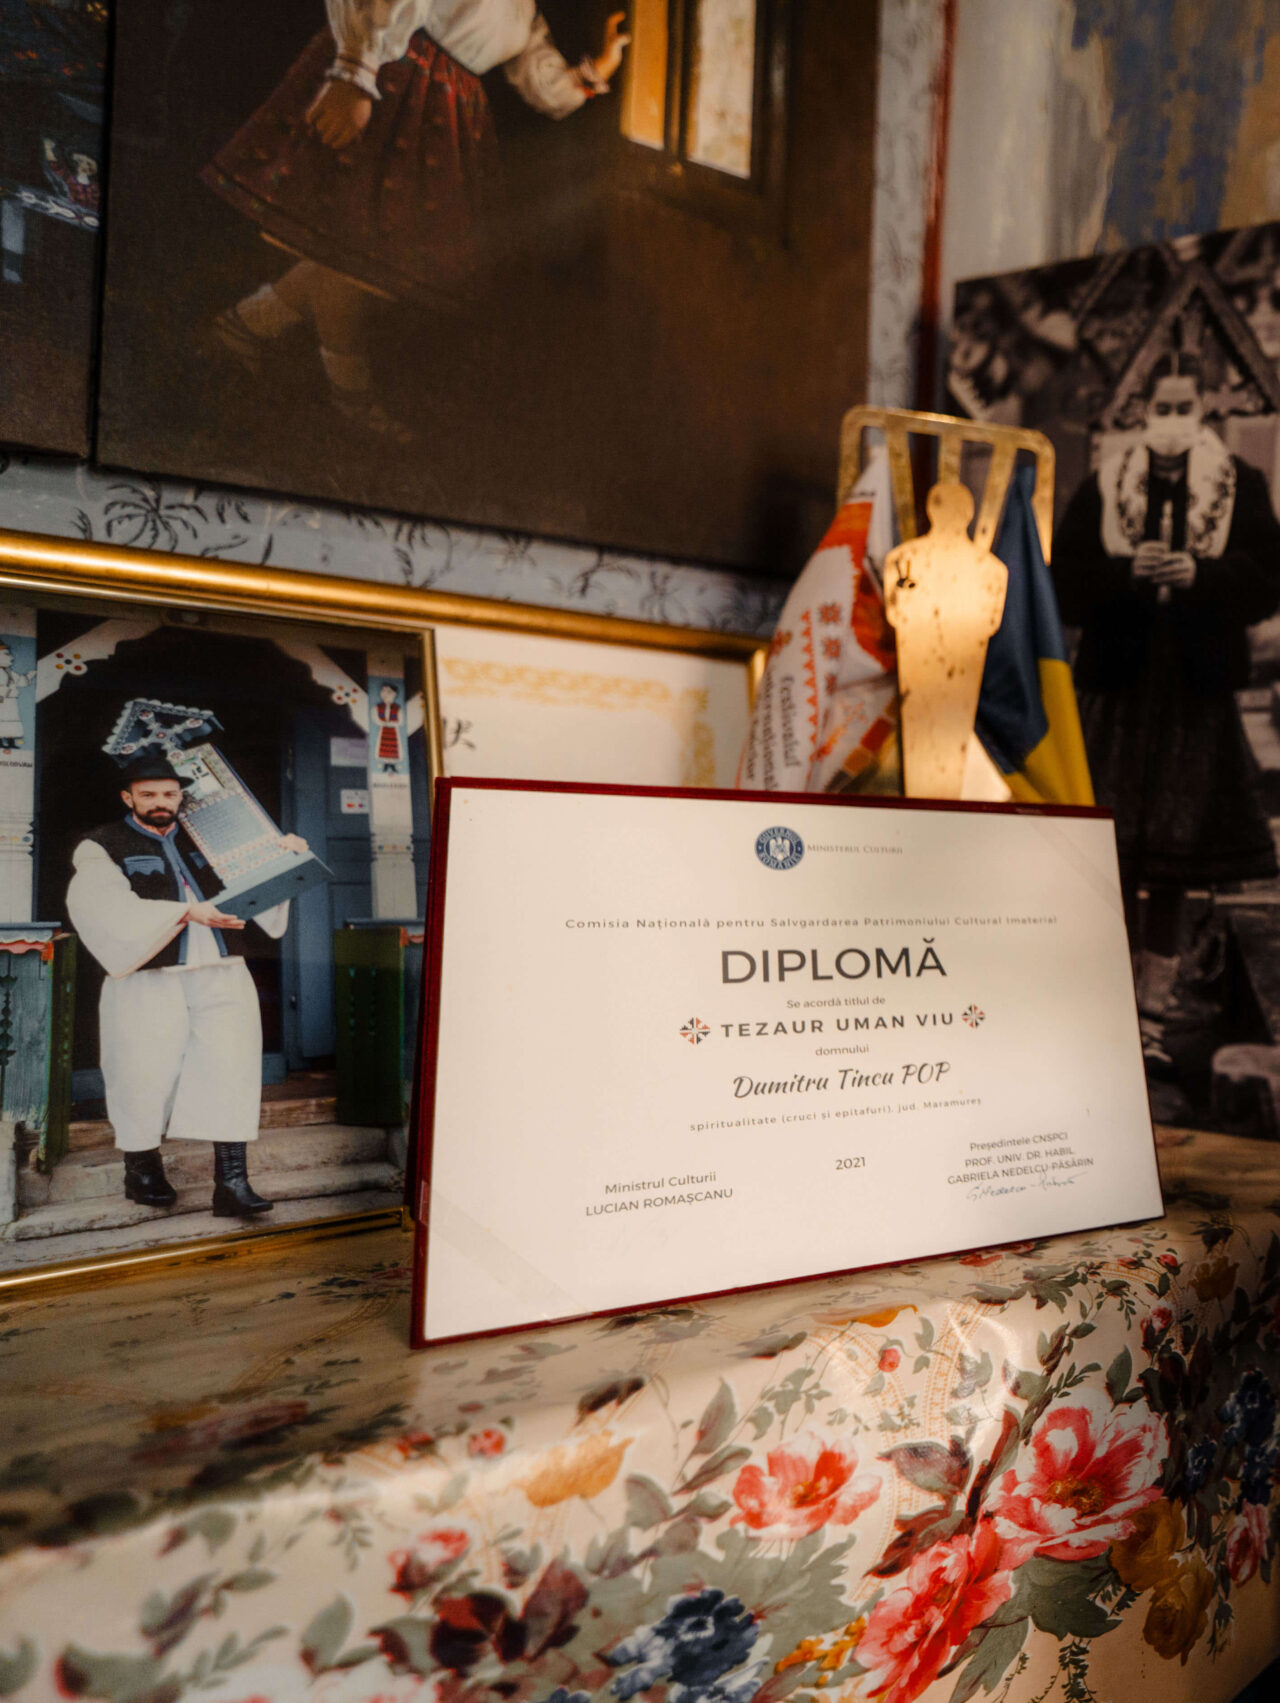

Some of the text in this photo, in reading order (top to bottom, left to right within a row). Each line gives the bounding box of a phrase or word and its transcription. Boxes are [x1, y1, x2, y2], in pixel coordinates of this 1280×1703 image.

[565, 915, 1057, 930] Comisia Națională pentru Salvgardarea Patrimoniului Cultural Imaterial
[721, 937, 948, 985] DIPLOMĂ
[786, 999, 801, 1009] Se
[872, 995, 886, 1005] de
[720, 1012, 954, 1038] TEZAUR UMAN VIU
[814, 1044, 870, 1057] domnului
[732, 1061, 950, 1099] Dumitru Tincu POP
[689, 1116, 777, 1133] spiritualitate
[781, 1111, 817, 1124] (cruci
[1032, 1132, 1068, 1144] CNSPCI
[835, 1156, 866, 1171] 2021
[604, 1171, 717, 1195] Ministrul Culturii
[947, 1170, 1001, 1185] GABRIELA
[585, 1187, 733, 1217] LUCIAN ROMAȘCANU
